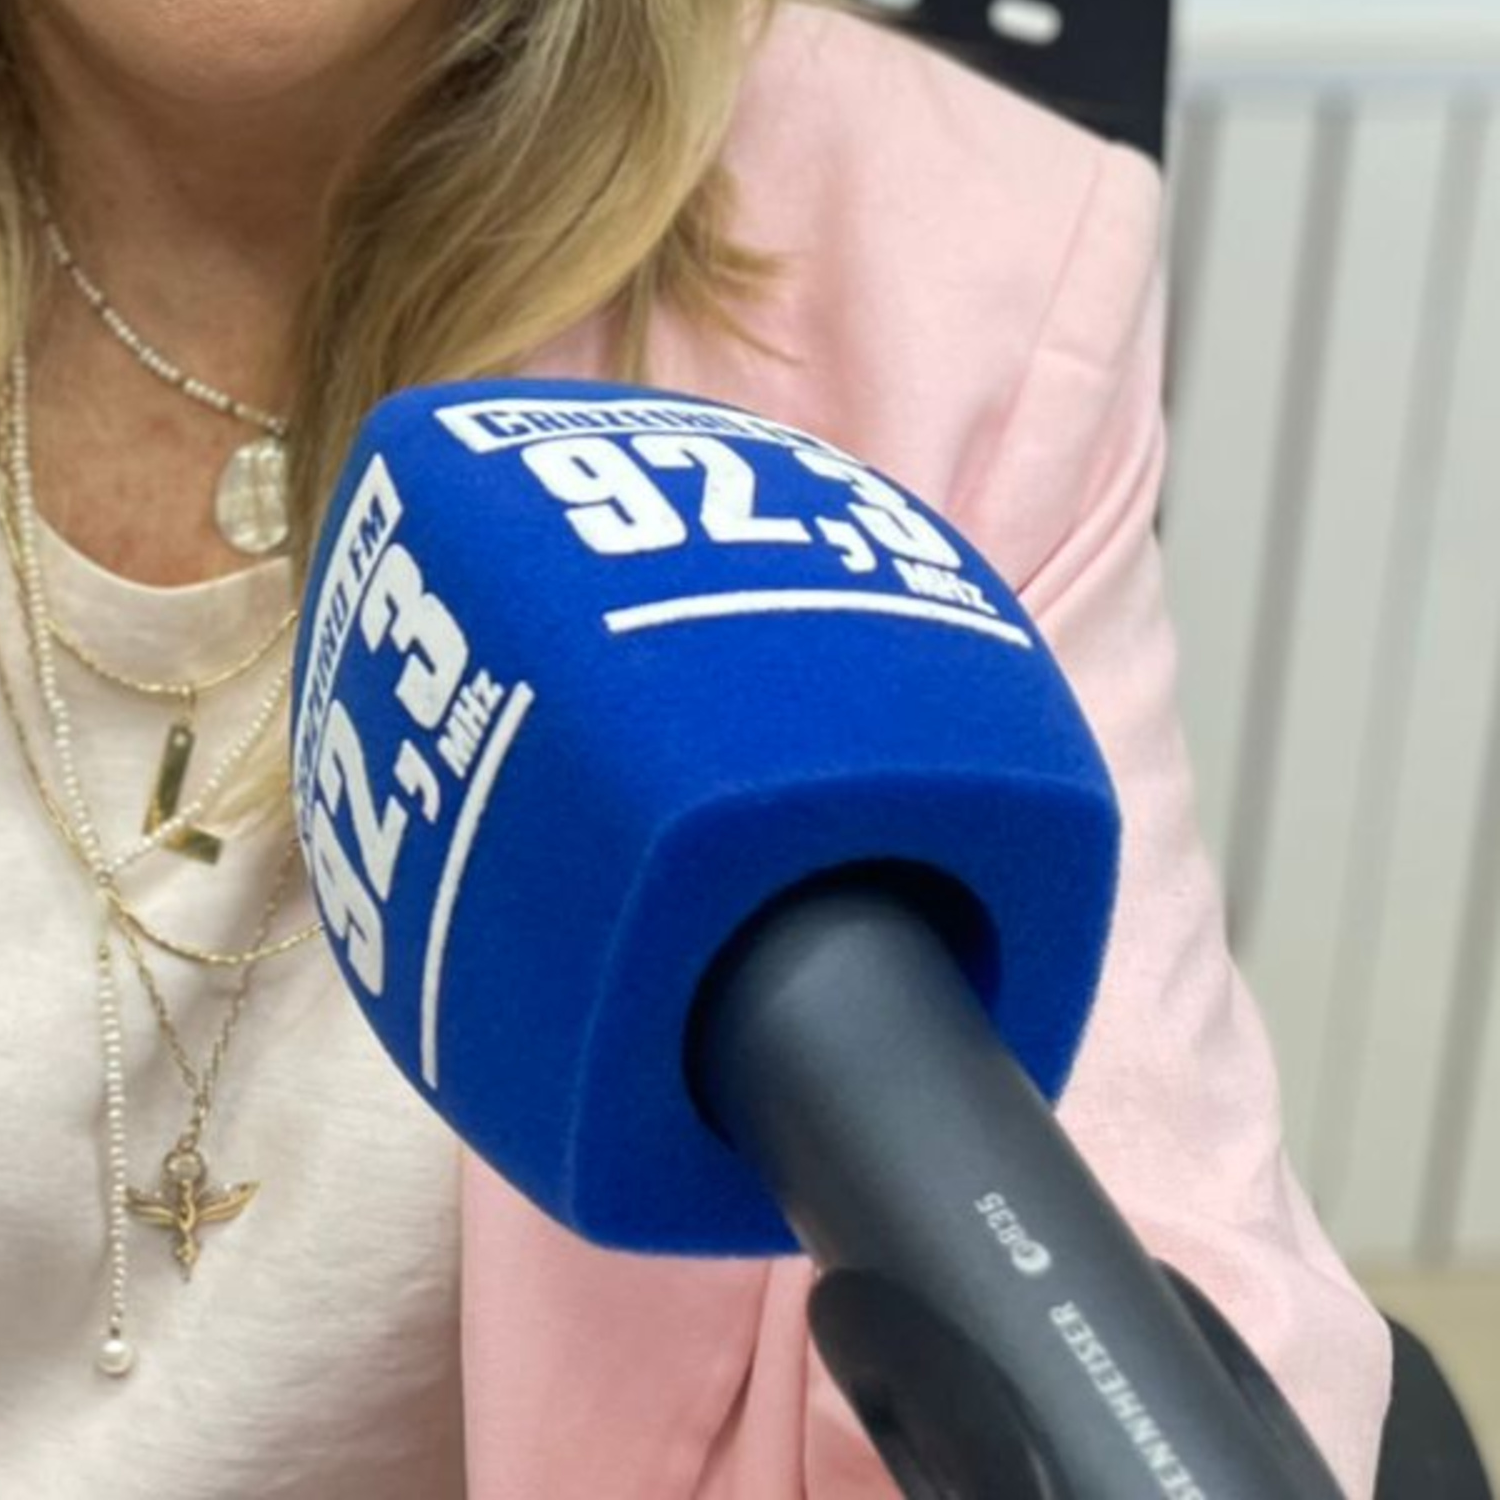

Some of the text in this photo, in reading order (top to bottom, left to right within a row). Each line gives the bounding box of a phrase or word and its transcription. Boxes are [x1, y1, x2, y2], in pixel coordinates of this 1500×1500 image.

[348, 497, 389, 583] FM
[521, 433, 962, 573] 92,3
[312, 542, 469, 997] 92,3
[437, 668, 505, 779] MHz
